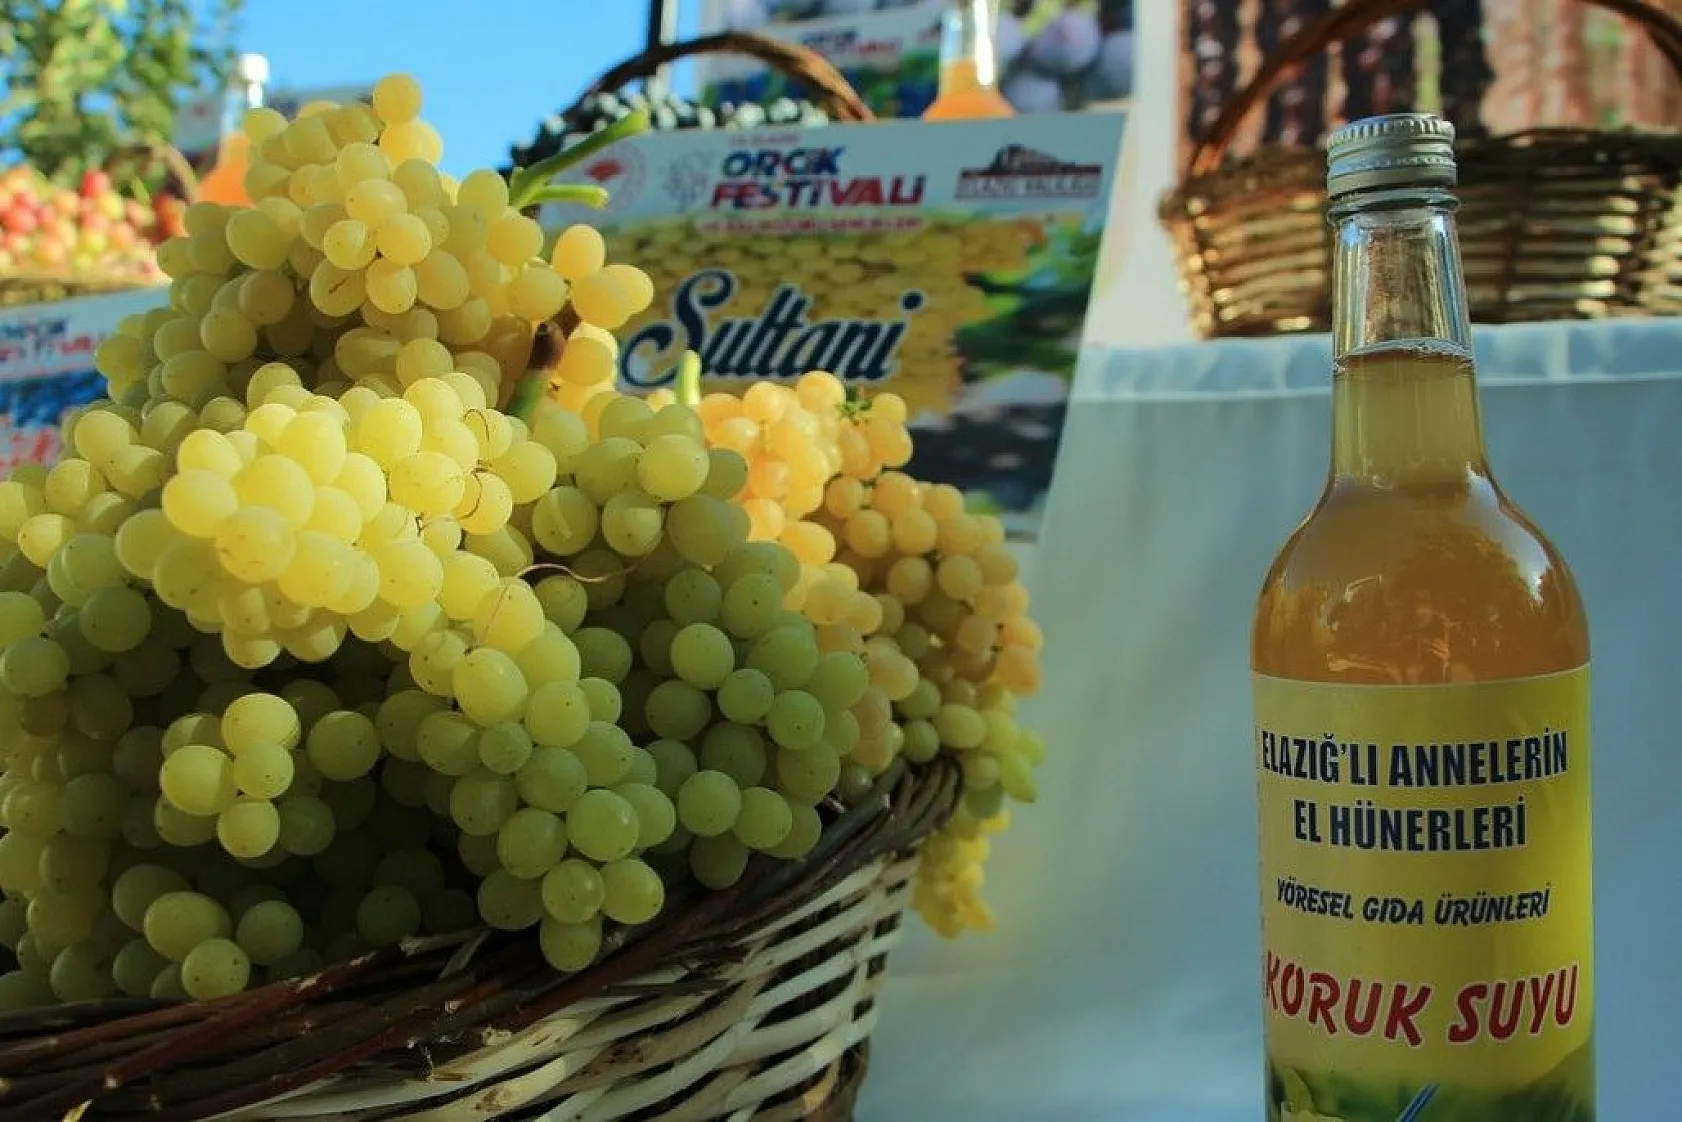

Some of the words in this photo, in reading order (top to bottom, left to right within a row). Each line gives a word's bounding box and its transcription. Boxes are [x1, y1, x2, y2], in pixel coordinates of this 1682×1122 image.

[620, 269, 926, 387] Sultani
[1388, 727, 1568, 786] ANNELERİN
[1294, 799, 1322, 844] EL
[1329, 796, 1527, 852] HÜNERLERİ
[1276, 876, 1354, 920] YÖRESEL
[1362, 896, 1424, 926] GIDA
[1433, 882, 1552, 927] ÜRÜNLERİ
[1265, 950, 1432, 1047] KORUK
[1447, 964, 1579, 1044] SUYU
